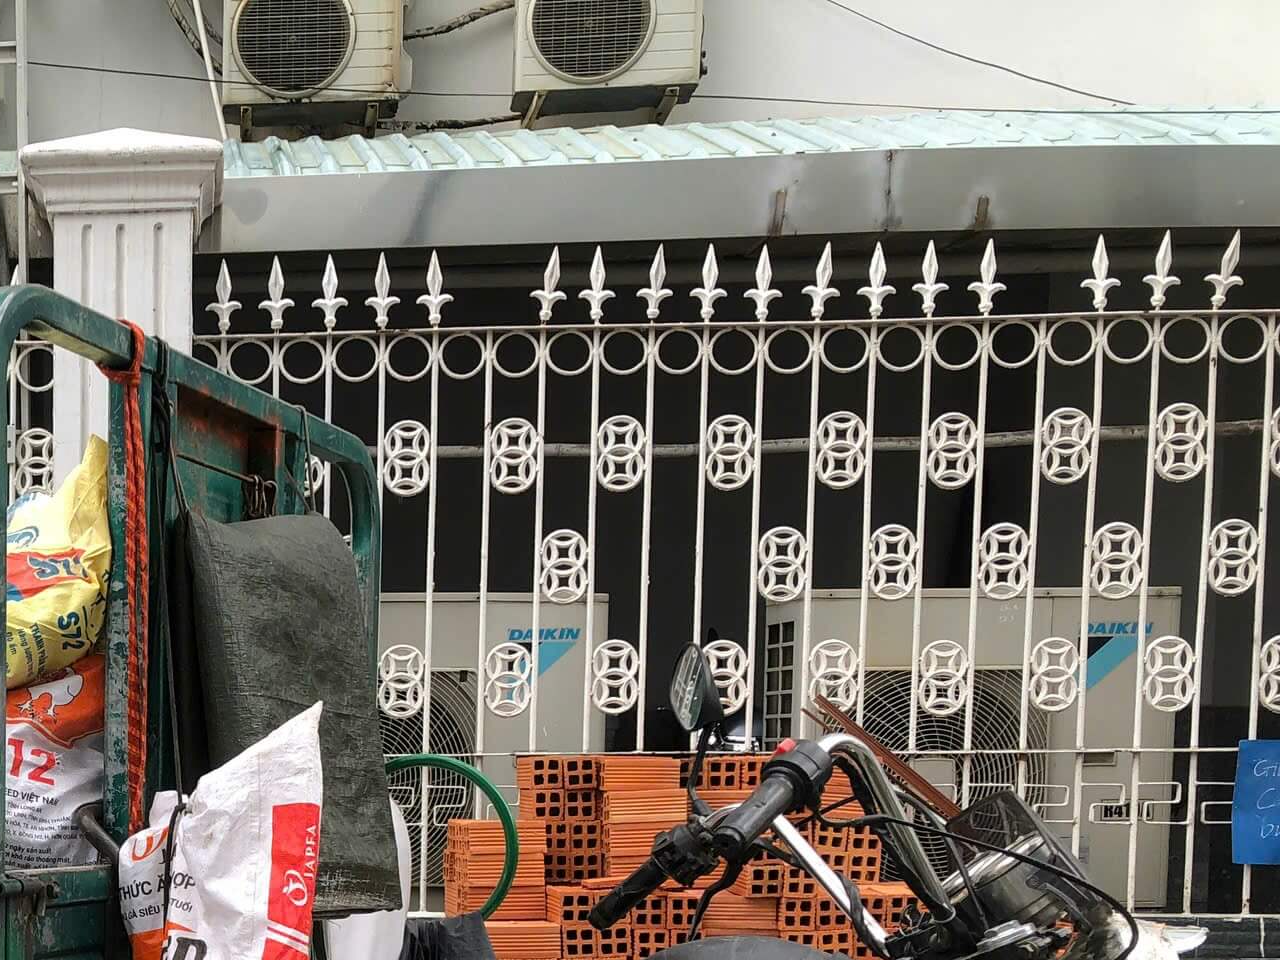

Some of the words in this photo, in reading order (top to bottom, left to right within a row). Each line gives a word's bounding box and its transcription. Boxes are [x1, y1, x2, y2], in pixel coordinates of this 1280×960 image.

[57, 612, 83, 650] S72
[508, 628, 581, 641] DAIKIN
[21, 790, 40, 804] VIỆT
[305, 824, 317, 880] JAPFA
[139, 905, 161, 918] SIÊU
[170, 897, 193, 913] TUỔI
